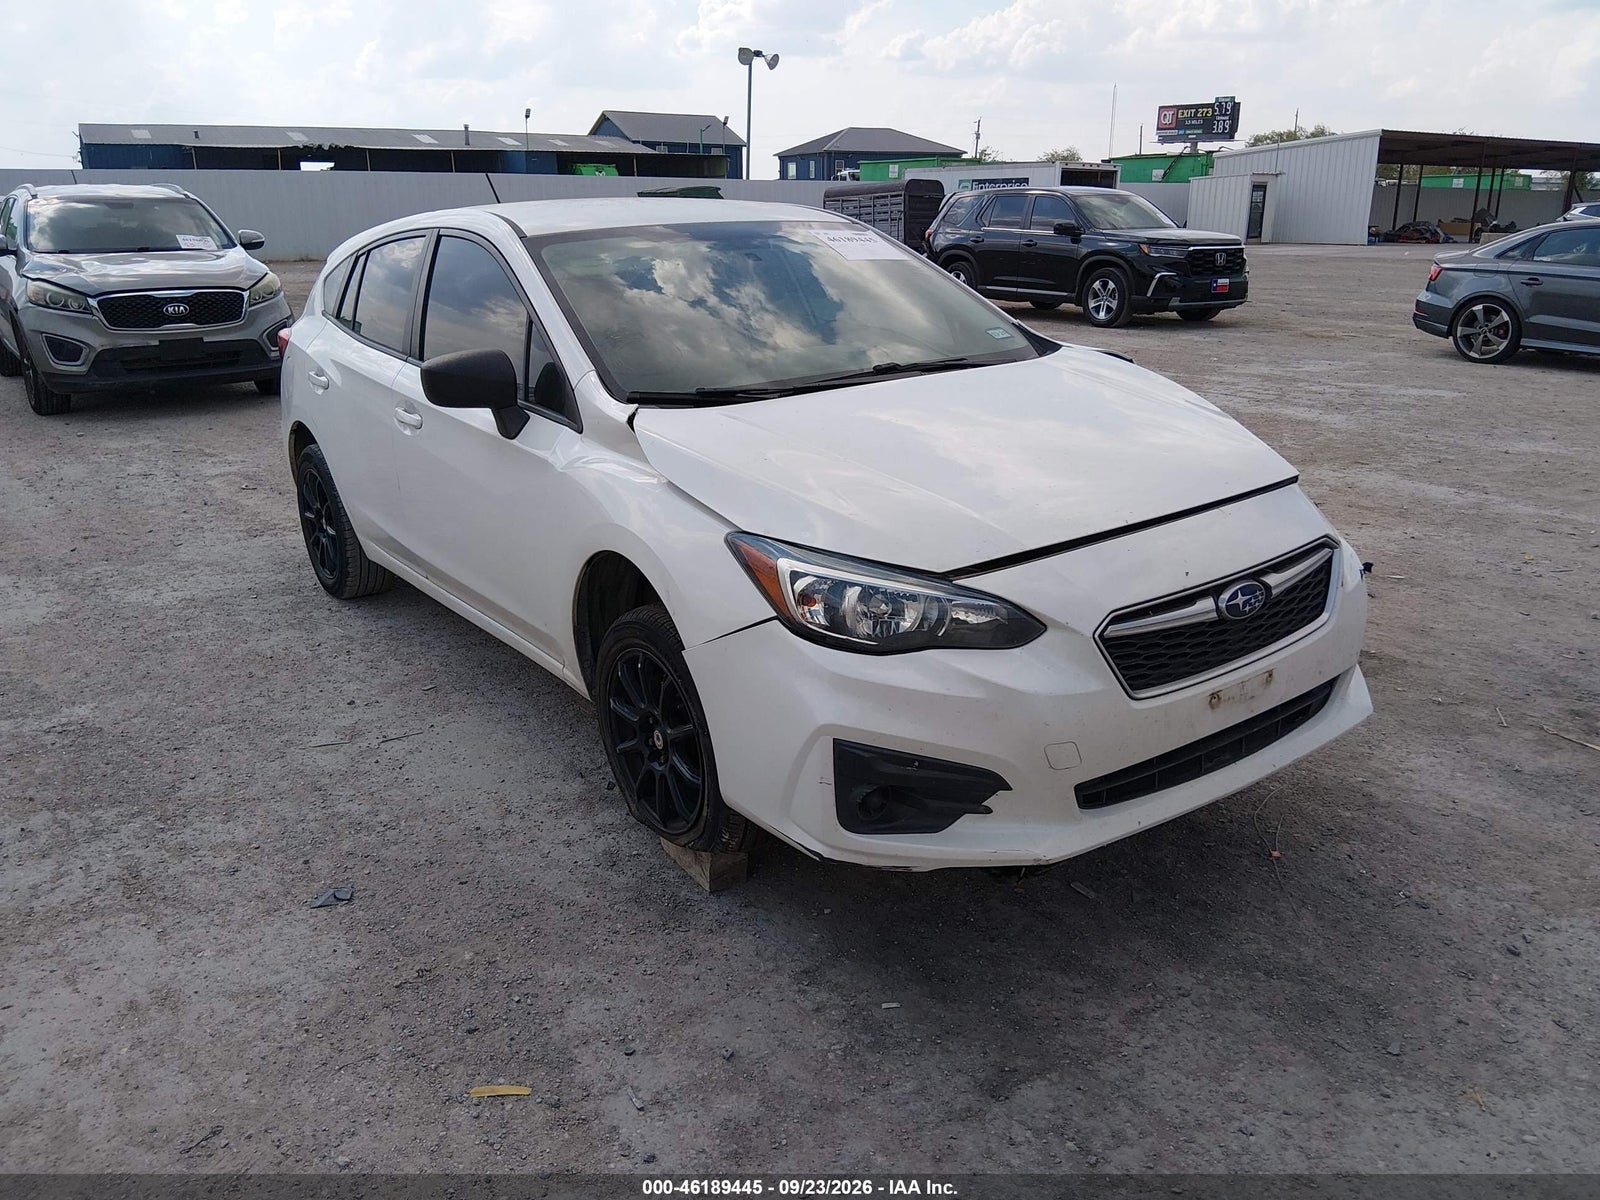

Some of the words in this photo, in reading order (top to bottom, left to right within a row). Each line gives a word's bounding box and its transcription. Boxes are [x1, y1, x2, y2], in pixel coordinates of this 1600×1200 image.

[1161, 111, 1174, 125] QT
[1178, 109, 1196, 118] EXIT
[1197, 108, 1213, 117] 273
[972, 180, 1028, 191] Enterprise
[167, 306, 186, 314] KIA
